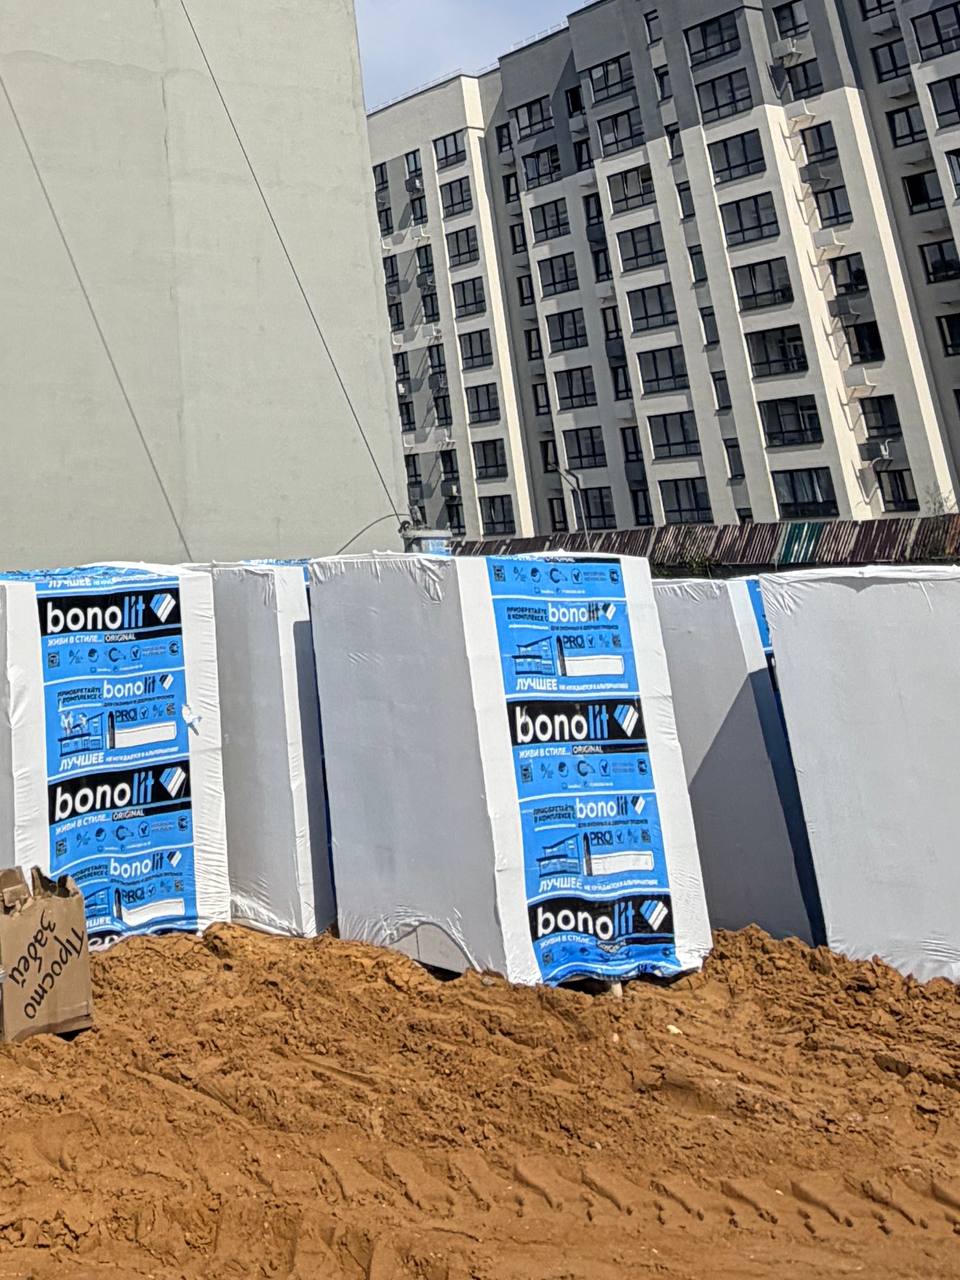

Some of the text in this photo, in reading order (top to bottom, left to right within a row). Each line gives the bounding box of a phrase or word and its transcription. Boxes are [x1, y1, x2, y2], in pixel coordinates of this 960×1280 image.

[46, 595, 145, 634] bonolit
[548, 601, 600, 622] bonolit
[105, 633, 136, 642] ORIGINAL
[103, 675, 156, 699] bonolit
[516, 678, 557, 690] ЛУЧШЕЕ
[515, 704, 609, 743] bonolit
[572, 745, 603, 754] ORIGINAL
[59, 752, 105, 772] ЛУЧШЕЕ
[54, 770, 155, 822] bonolit
[576, 796, 628, 818] bonolit
[112, 809, 145, 820] ORIGINAL
[110, 851, 163, 878] bonolit
[539, 877, 582, 893] ЛУЧШЕЕ
[537, 901, 635, 940] bonolit
[9, 910, 56, 988] Забей
[24, 928, 84, 1019] Просто
